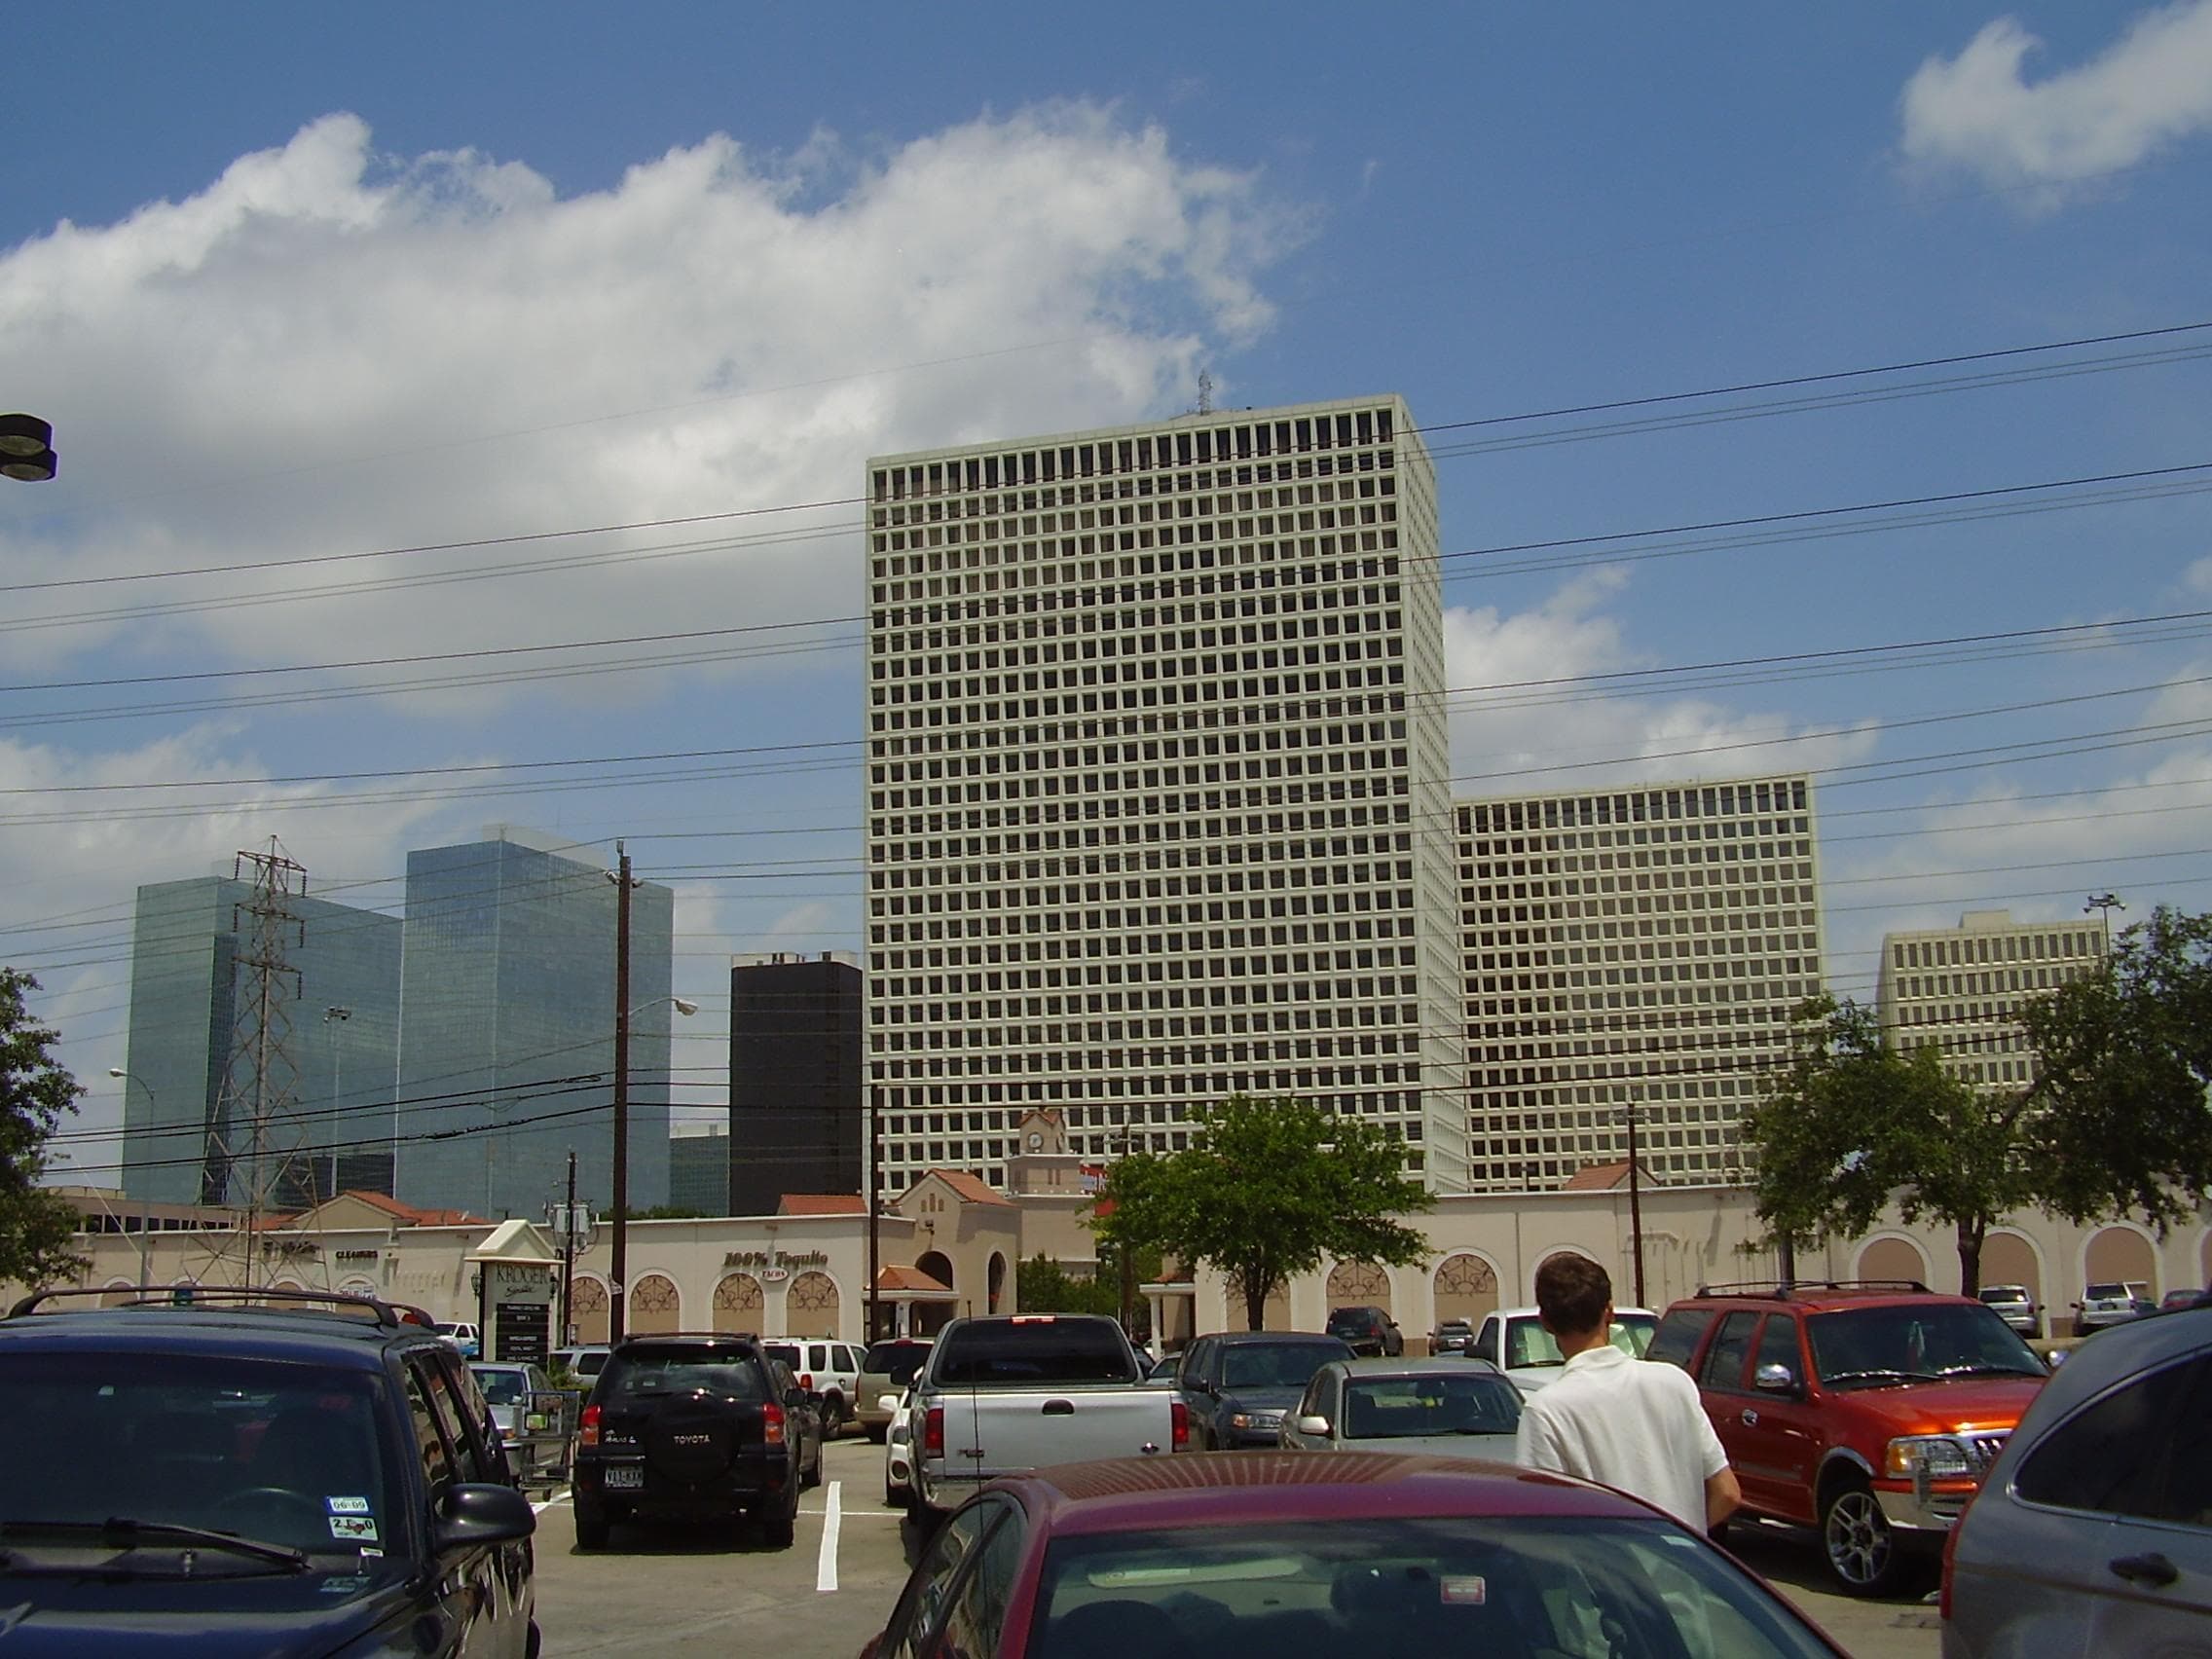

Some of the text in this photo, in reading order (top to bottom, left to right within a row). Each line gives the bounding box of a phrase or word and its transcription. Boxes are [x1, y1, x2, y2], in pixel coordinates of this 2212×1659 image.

[335, 1250, 378, 1259] CLEANERS
[724, 1252, 768, 1266] 100%
[497, 1265, 549, 1284] KROGER
[674, 1434, 710, 1445] TOYOTA
